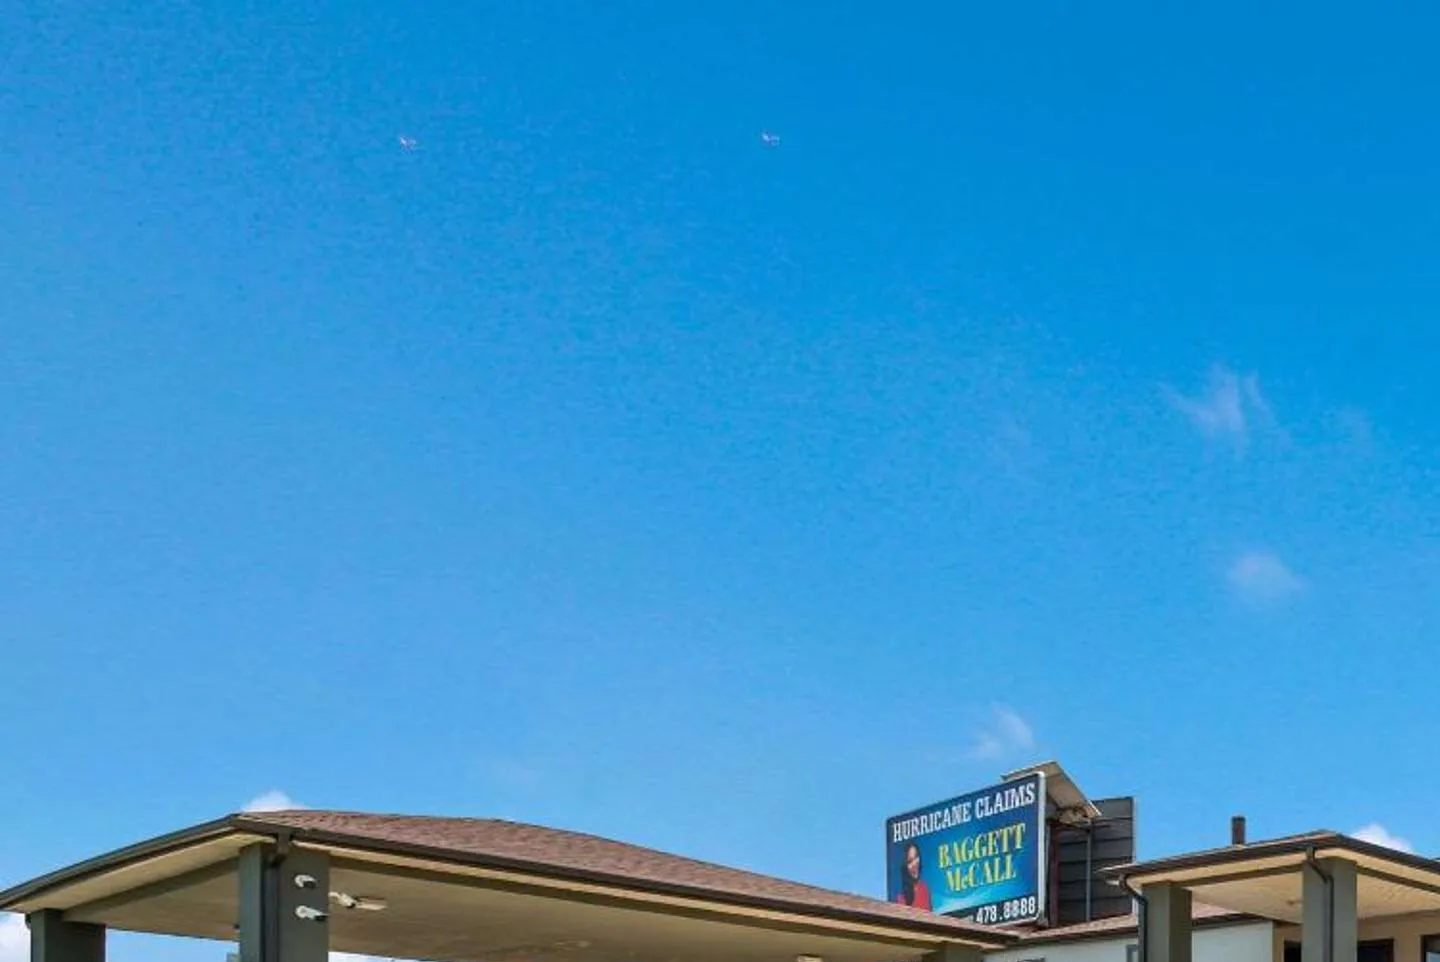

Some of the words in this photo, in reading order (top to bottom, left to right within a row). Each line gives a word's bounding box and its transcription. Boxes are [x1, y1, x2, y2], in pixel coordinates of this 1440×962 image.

[893, 802, 972, 843] HURRICANE
[975, 783, 1035, 819] CLAIMS
[938, 823, 1026, 868] BAGGETT
[946, 854, 1016, 891] McCALL
[976, 896, 1036, 924] 478.8888
